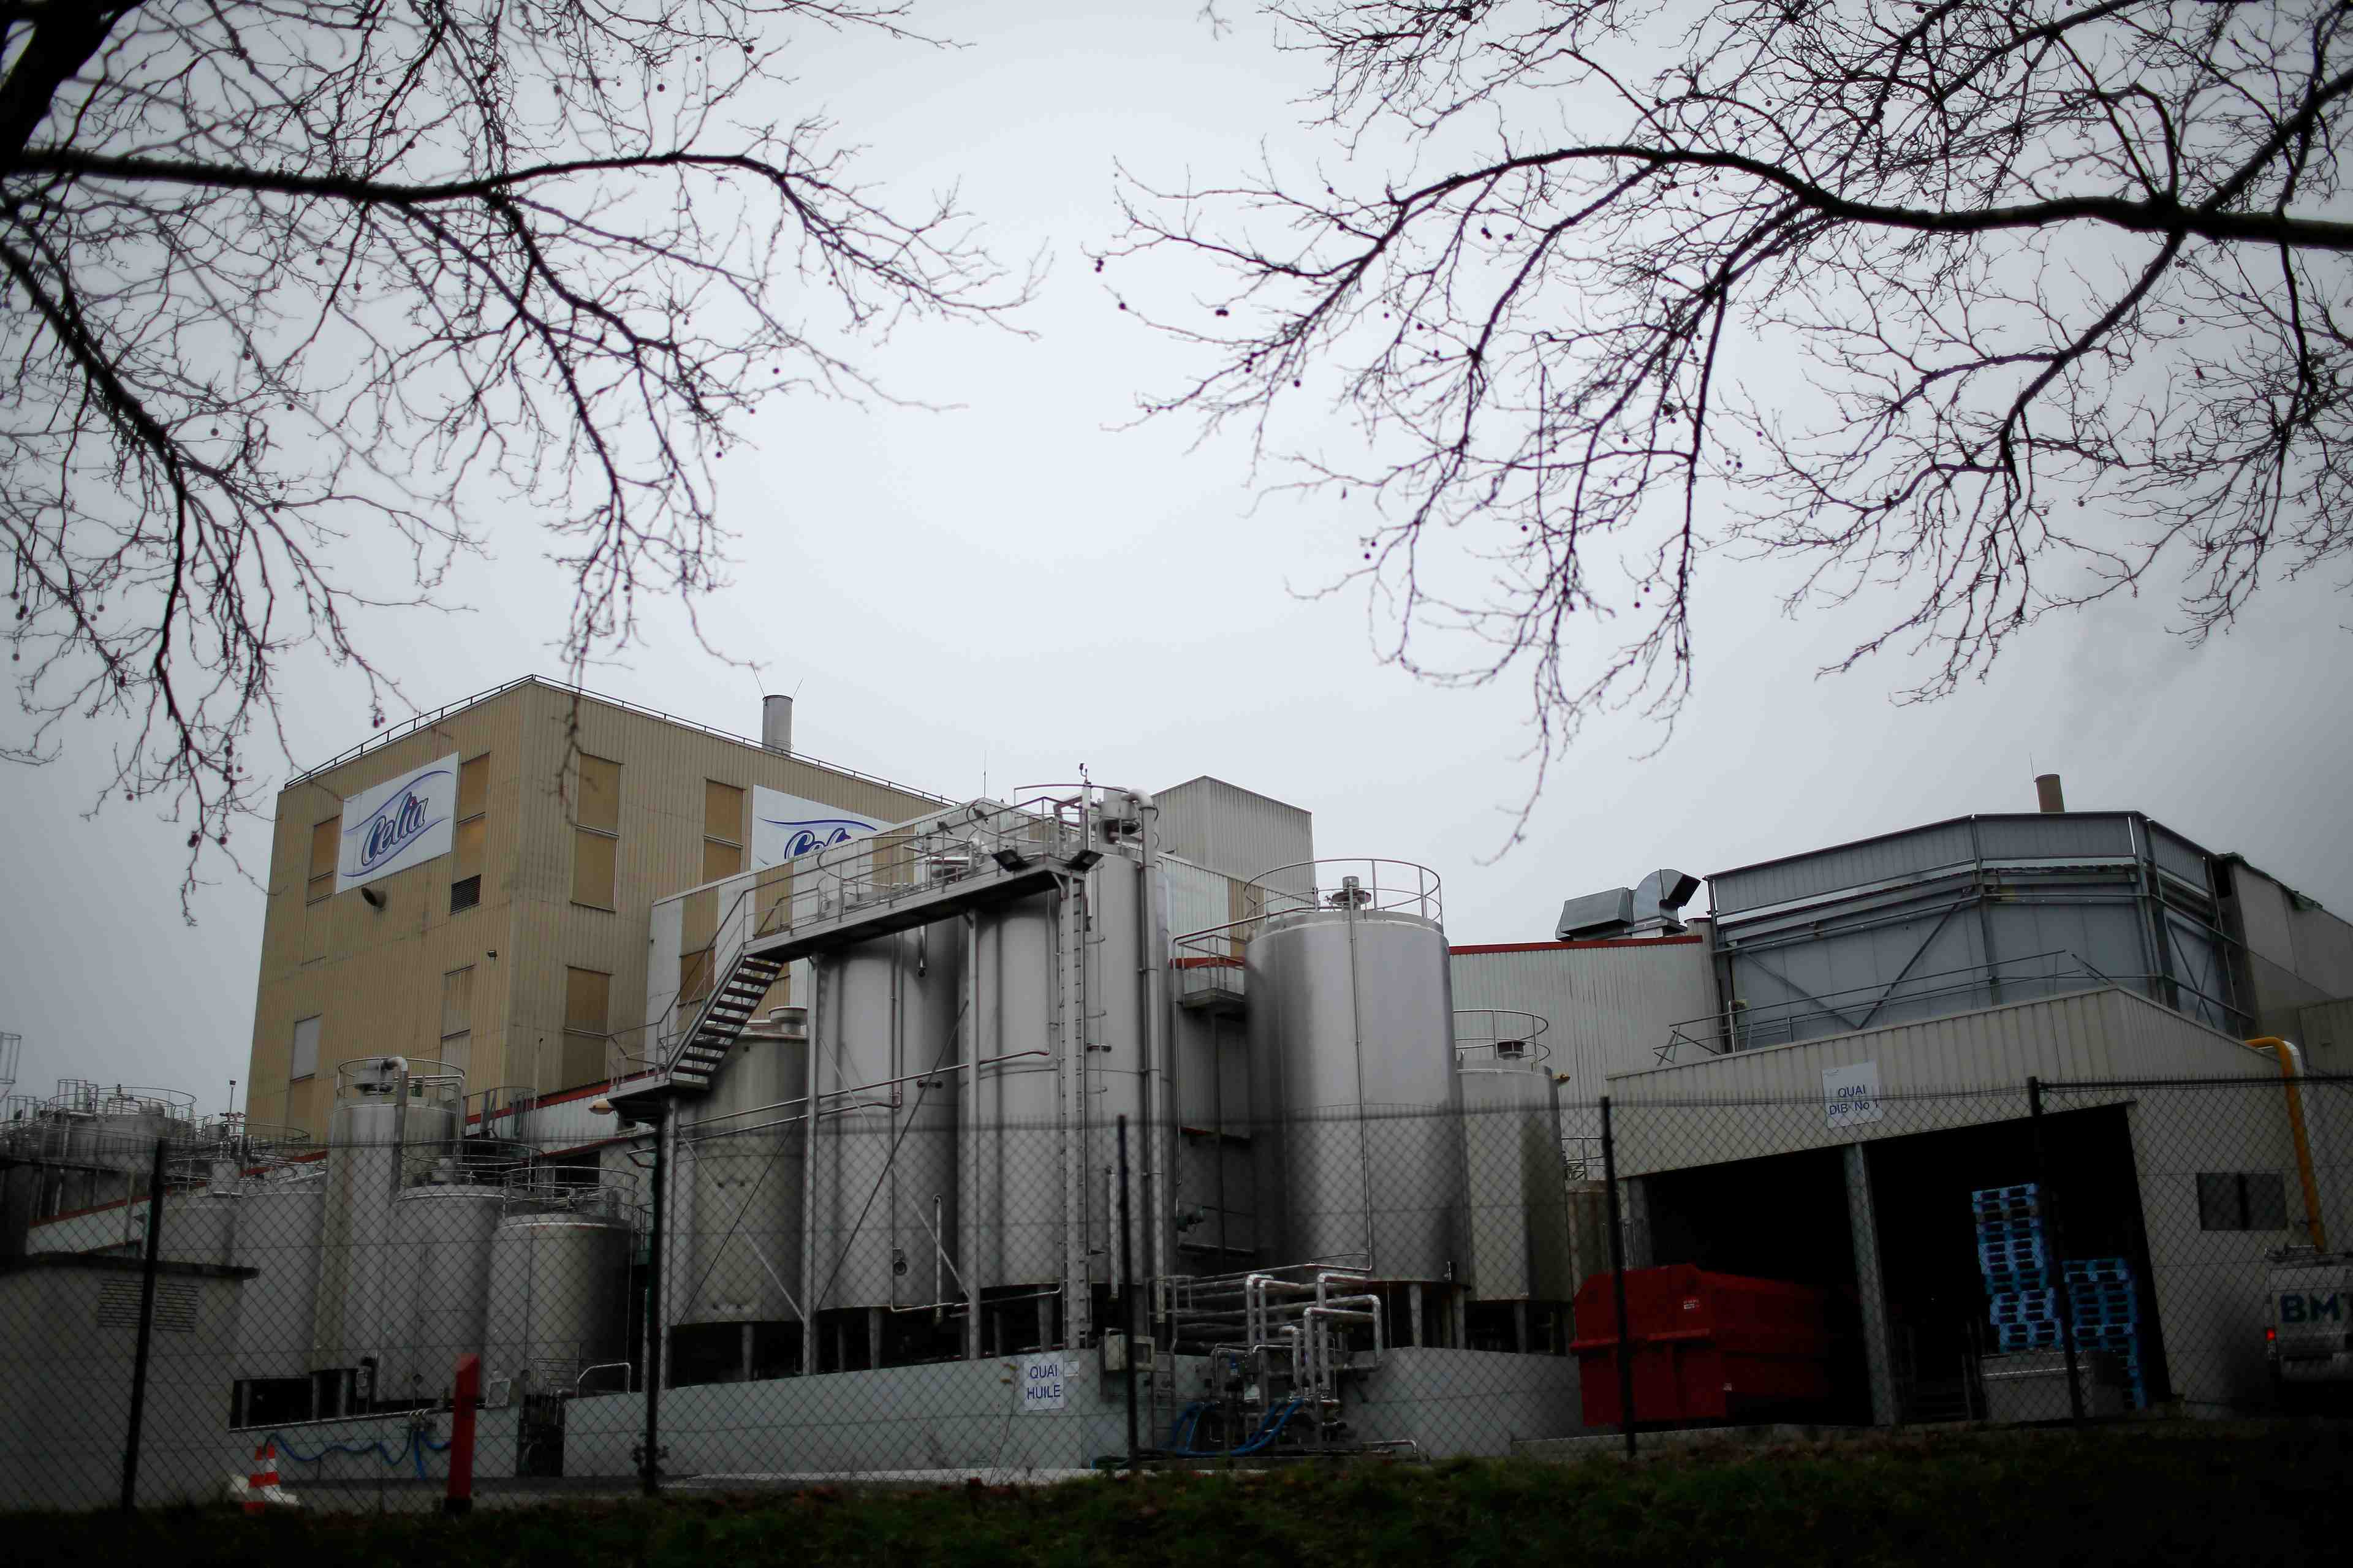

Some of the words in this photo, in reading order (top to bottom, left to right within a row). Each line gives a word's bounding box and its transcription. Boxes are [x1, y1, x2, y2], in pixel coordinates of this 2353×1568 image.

[362, 791, 429, 866] Celia
[1838, 1084, 1865, 1098] QUAI
[1829, 1103, 1848, 1115] DIB
[1030, 1364, 1058, 1379] QUAI
[1027, 1385, 1061, 1399] HUILE
